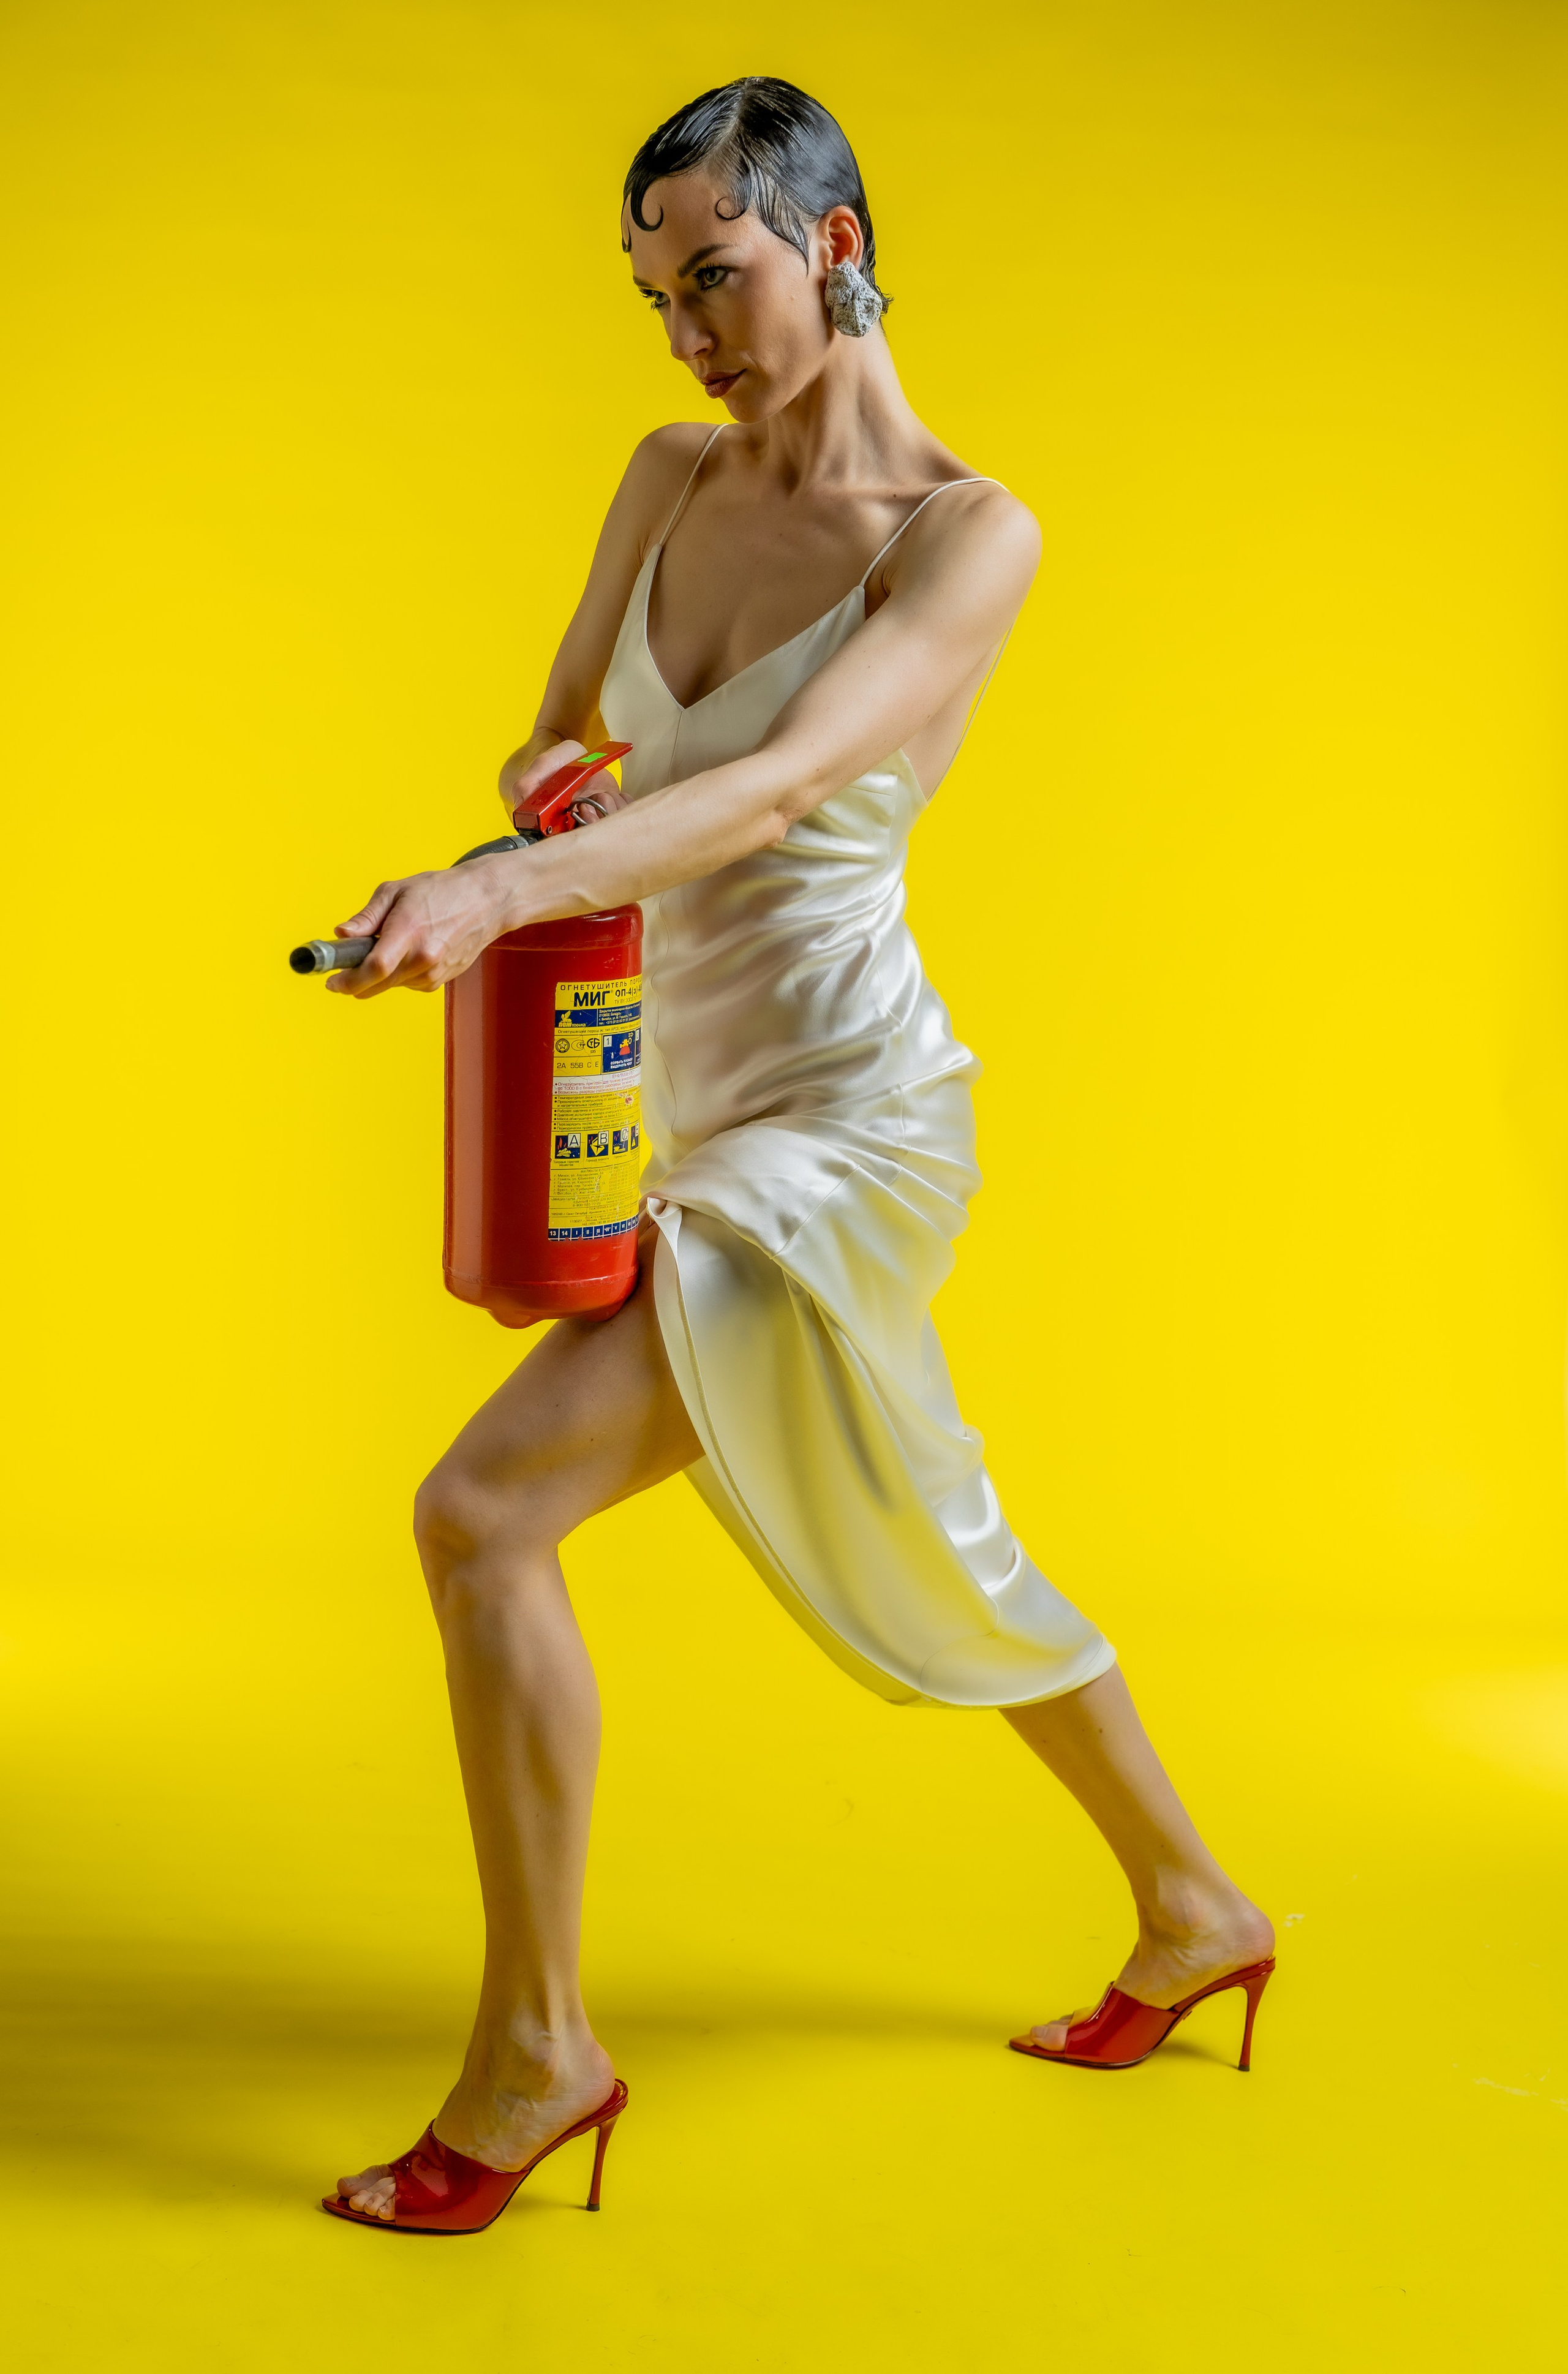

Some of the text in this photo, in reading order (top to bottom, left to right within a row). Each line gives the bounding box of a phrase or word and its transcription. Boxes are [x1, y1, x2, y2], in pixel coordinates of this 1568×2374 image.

[560, 981, 627, 991] ОГНЕТУШИТЕЛЬ
[574, 990, 610, 1007] МИГ
[570, 1135, 579, 1146] A
[600, 1133, 607, 1144] B
